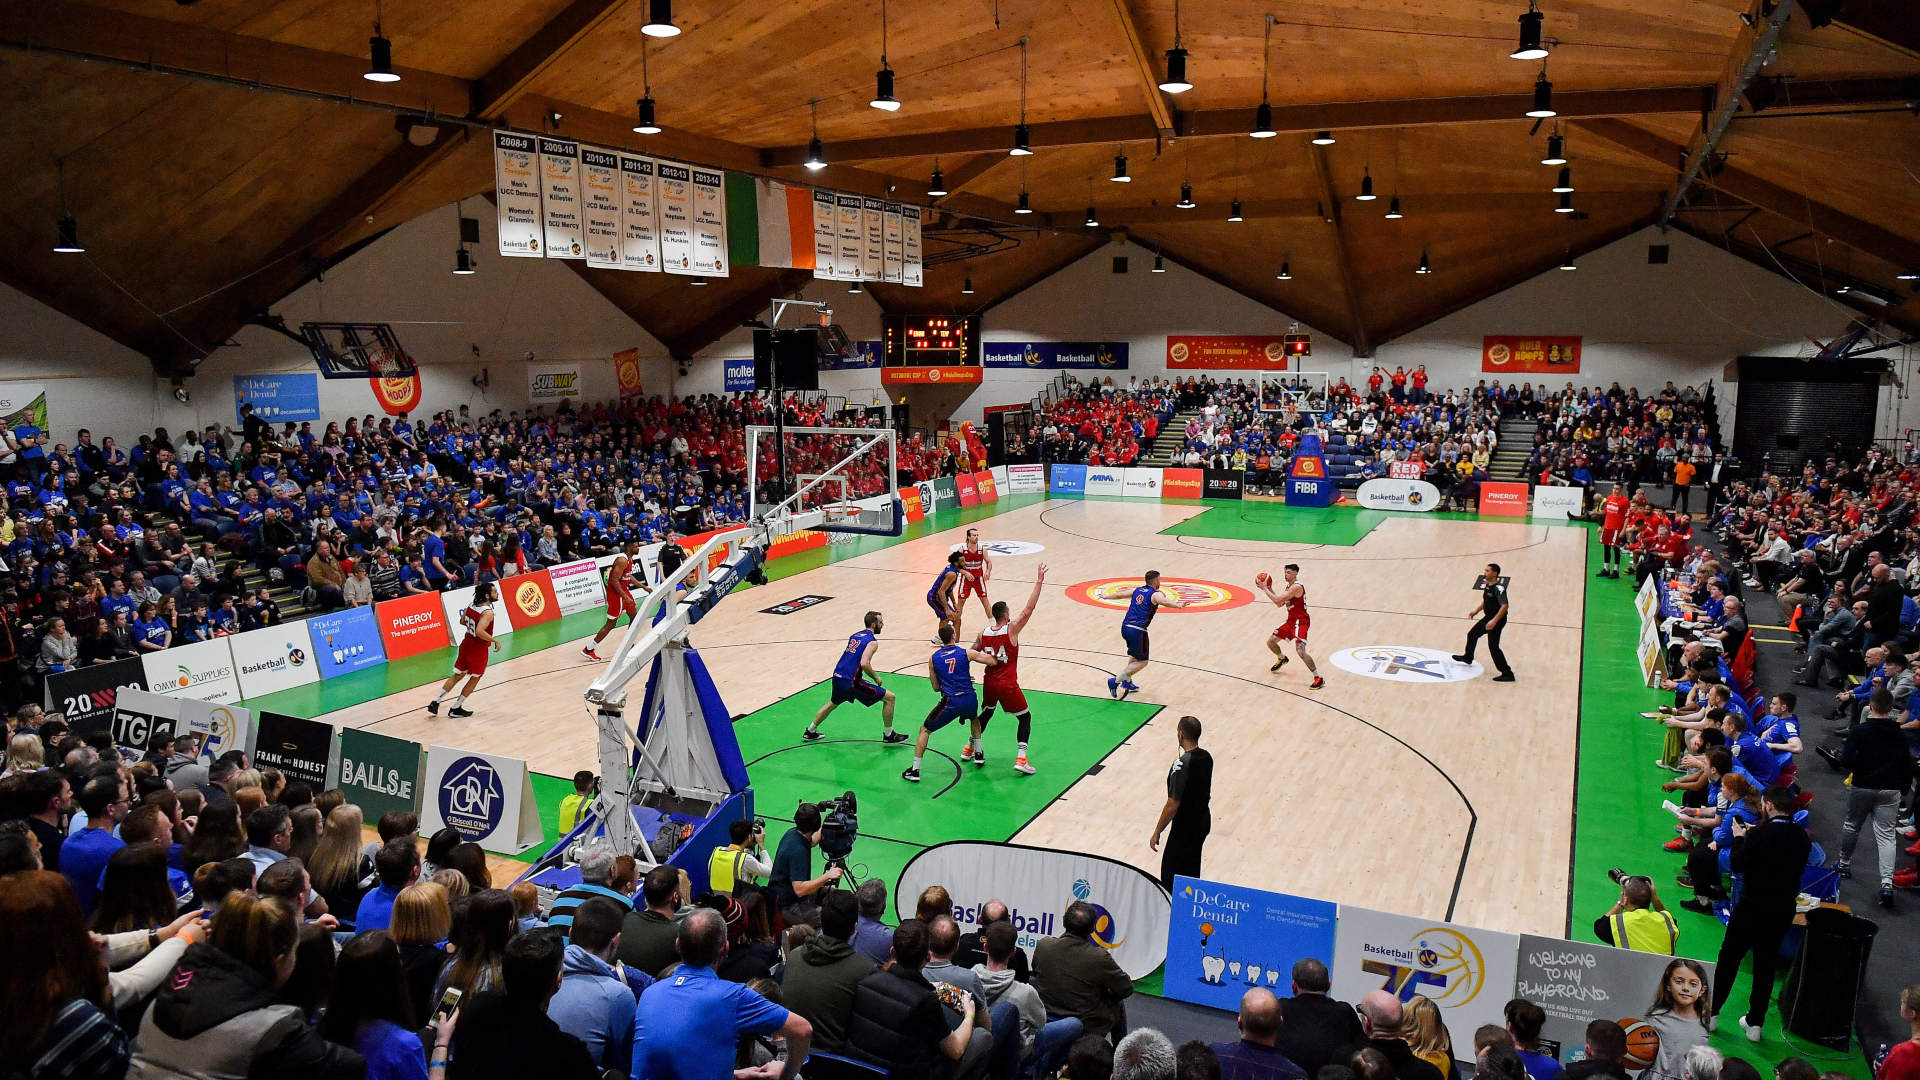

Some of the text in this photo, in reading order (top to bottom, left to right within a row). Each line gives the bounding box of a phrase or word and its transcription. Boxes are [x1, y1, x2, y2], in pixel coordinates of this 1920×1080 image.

[501, 137, 527, 148] 2008-9
[544, 143, 574, 154] 2009-10
[586, 154, 613, 165] 2010-11
[624, 161, 651, 172] 2011-12
[662, 167, 687, 178] 2012-13
[696, 174, 718, 184] 2013-14
[590, 220, 616, 228] Women's
[249, 380, 281, 389] DeCare
[532, 371, 578, 391] SUBWAY
[250, 390, 276, 398] Dental
[1393, 462, 1419, 473] RED
[1295, 482, 1318, 494] FIBA
[568, 565, 585, 576] payments
[569, 577, 588, 586] complete
[716, 575, 739, 598] Sports
[556, 584, 582, 594] membership
[521, 588, 535, 604] HULA
[526, 593, 542, 613] HOOPS
[318, 619, 342, 629] DeCare
[392, 611, 432, 628] PINERGY
[320, 627, 340, 637] Dental
[401, 627, 416, 636] energy
[418, 622, 441, 631] innovators
[242, 657, 285, 675] Basketball
[944, 658, 956, 674] 7
[154, 680, 177, 692] OMW
[192, 666, 230, 683] SUPPLIES
[63, 694, 92, 716] 20
[118, 713, 147, 745] TG
[190, 720, 209, 729] Basketball
[256, 750, 282, 765] FRANK
[293, 759, 326, 774] HONEST
[300, 773, 324, 783] COMPANY
[447, 816, 472, 826] O'Driscoll
[1193, 889, 1250, 912] DeCare
[1192, 905, 1238, 925] Dental
[1266, 907, 1329, 923] Dental Insurance from
[1277, 915, 1296, 924] Dental
[1297, 919, 1319, 928] Experts
[1364, 943, 1413, 960] Basketball
[1544, 967, 1582, 987] TO MY
[1518, 981, 1610, 1001] PLAYGROUND.
[1545, 1010, 1574, 1020] ASKETBALL
